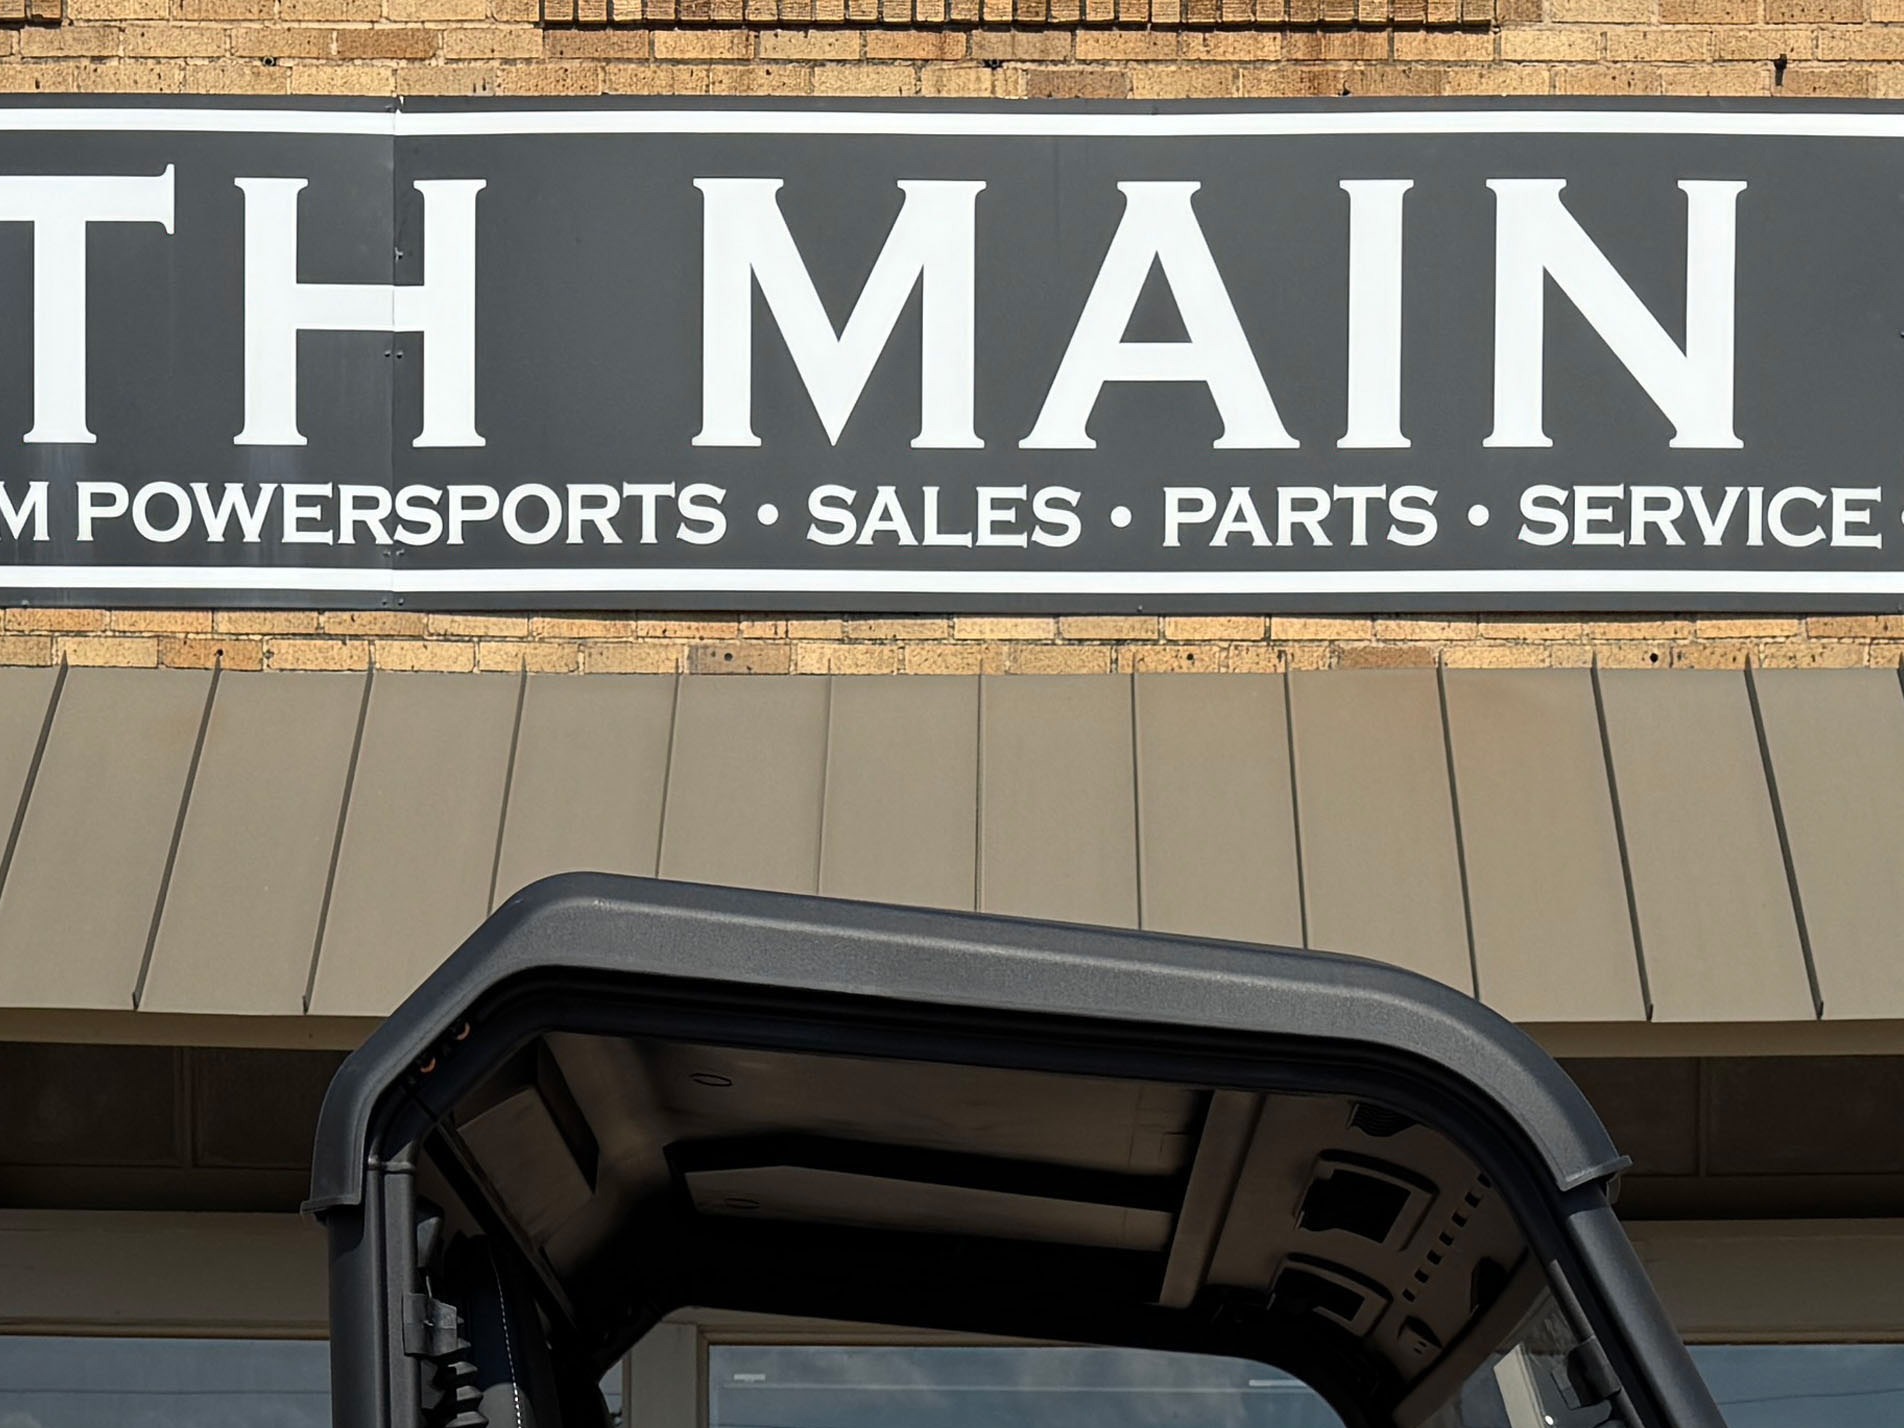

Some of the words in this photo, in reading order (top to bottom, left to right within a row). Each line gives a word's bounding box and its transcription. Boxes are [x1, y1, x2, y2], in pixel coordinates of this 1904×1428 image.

[692, 177, 1748, 449] MAIN
[76, 481, 727, 546] POWERSPORTS
[806, 484, 1082, 549] SALES
[1162, 483, 1438, 547] PARTS
[1517, 483, 1882, 550] SERVICE
